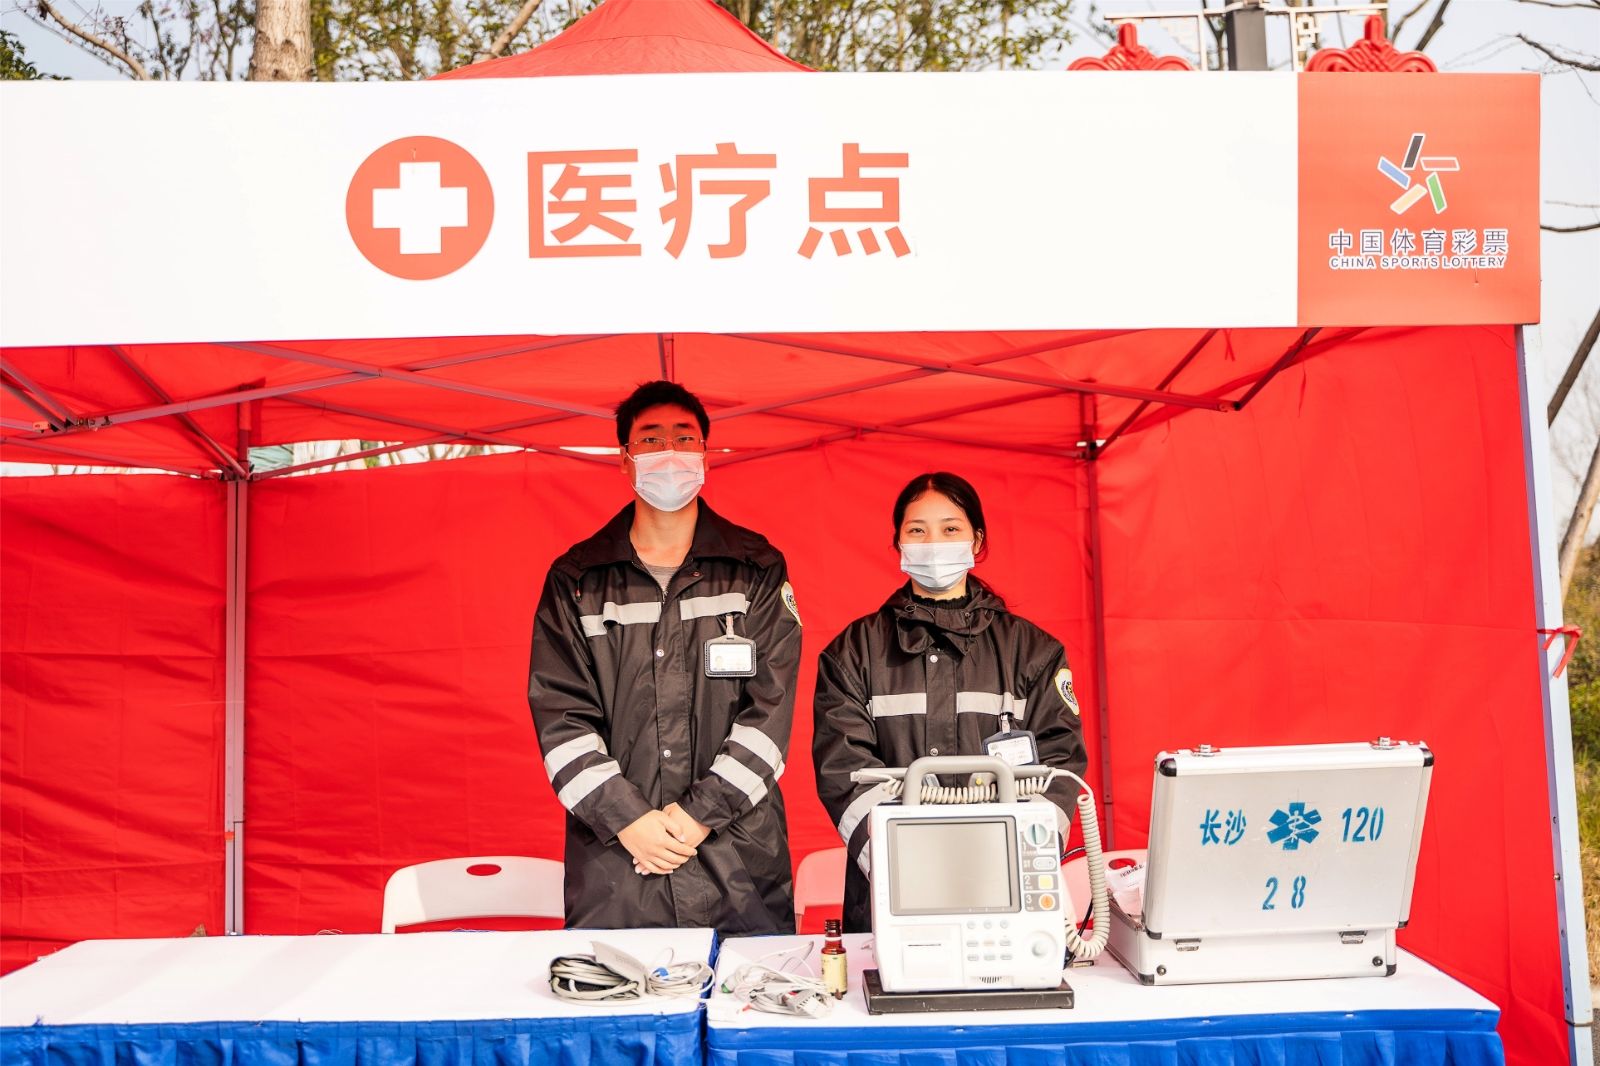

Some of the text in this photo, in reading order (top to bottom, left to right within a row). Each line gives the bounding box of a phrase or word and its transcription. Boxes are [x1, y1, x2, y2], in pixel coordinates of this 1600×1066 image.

[527, 142, 912, 260] 医疗点
[1330, 229, 1508, 255] 中国体育彩票
[1330, 256, 1505, 268] CHINA SPORTS LOTTERY
[1200, 807, 1385, 846] 长沙 120
[1024, 874, 1032, 886] 2
[1025, 894, 1033, 904] 3
